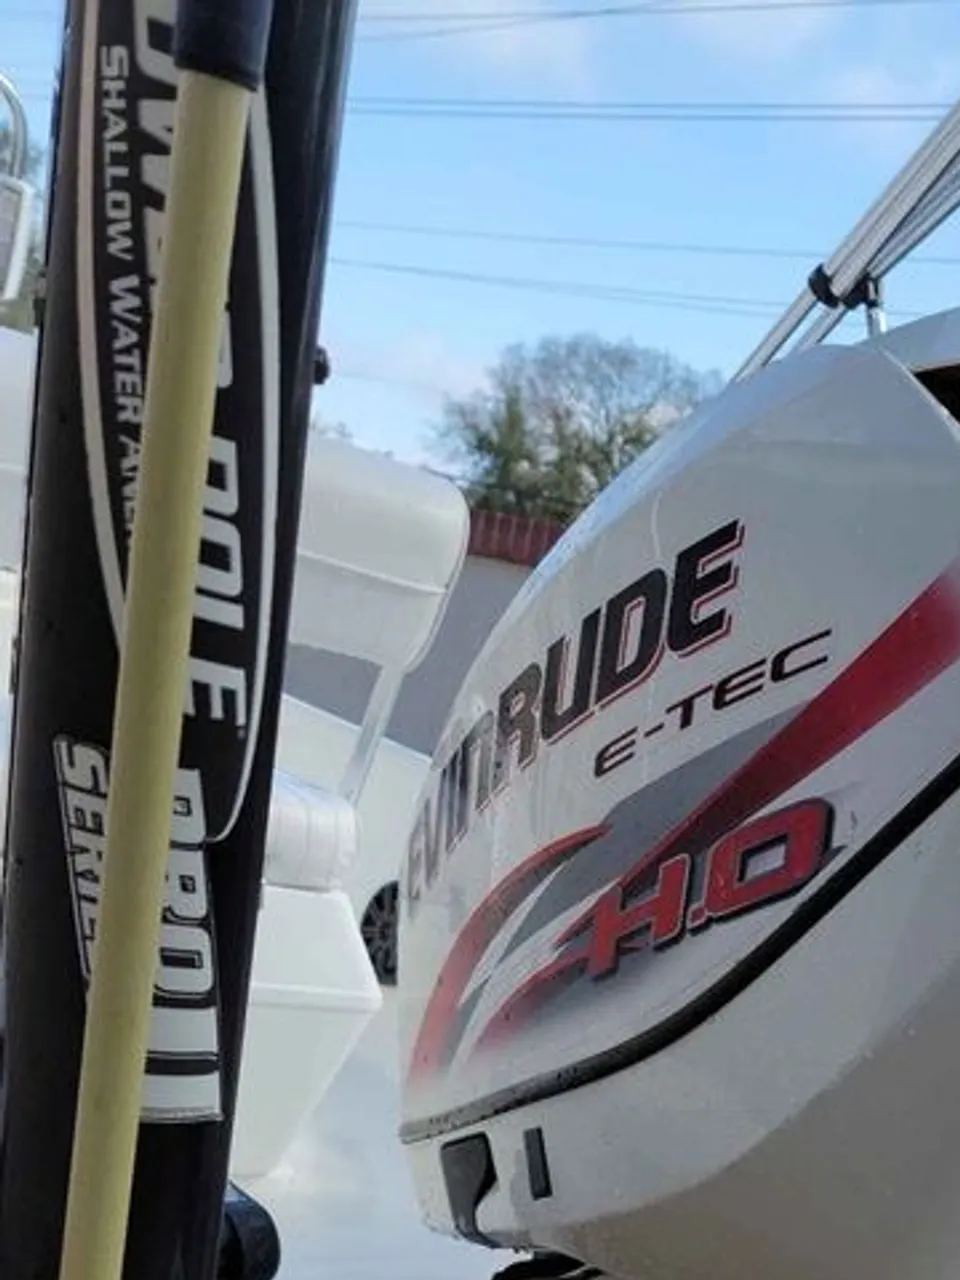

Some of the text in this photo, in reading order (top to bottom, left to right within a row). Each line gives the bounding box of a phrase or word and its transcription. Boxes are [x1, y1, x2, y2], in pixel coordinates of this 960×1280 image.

[100, 45, 134, 261] SHALLOW
[108, 274, 143, 423] WATER
[594, 628, 832, 777] E-TEC
[57, 740, 111, 980] SERI
[154, 767, 214, 1000] PRO
